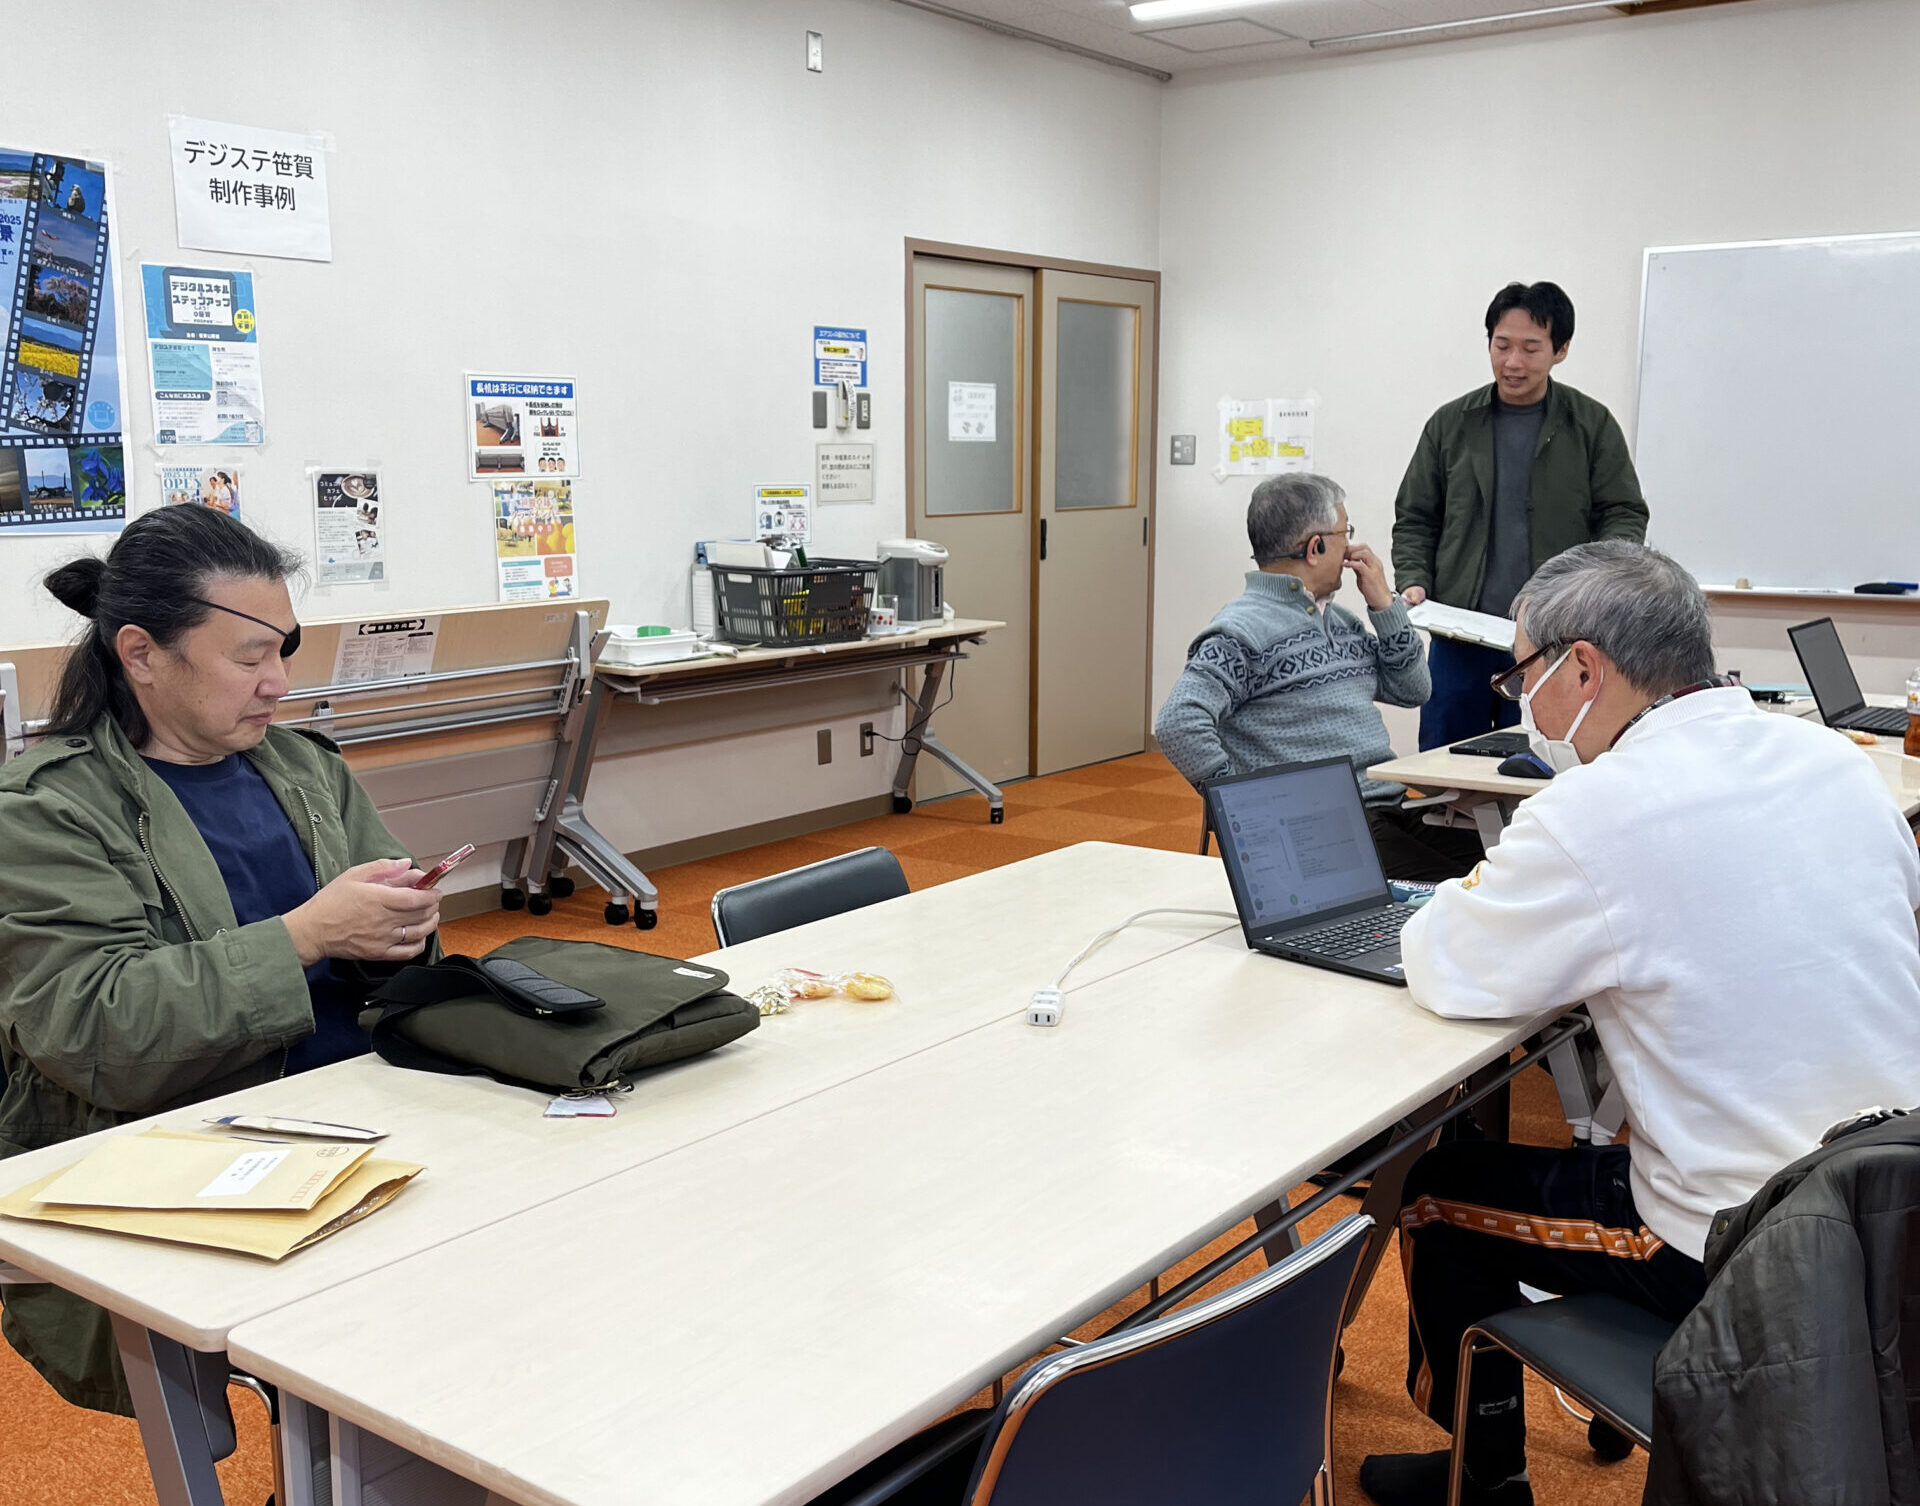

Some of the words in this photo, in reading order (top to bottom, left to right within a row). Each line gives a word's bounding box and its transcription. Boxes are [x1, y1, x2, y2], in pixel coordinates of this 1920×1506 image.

[184, 140, 314, 180] デジステ笹賀
[209, 178, 296, 211] 制作事例
[171, 281, 230, 294] デジタルスキル
[172, 294, 231, 307] ステップアップ
[476, 382, 569, 396] 長机は平行に収納できます
[163, 479, 201, 489] OPEN
